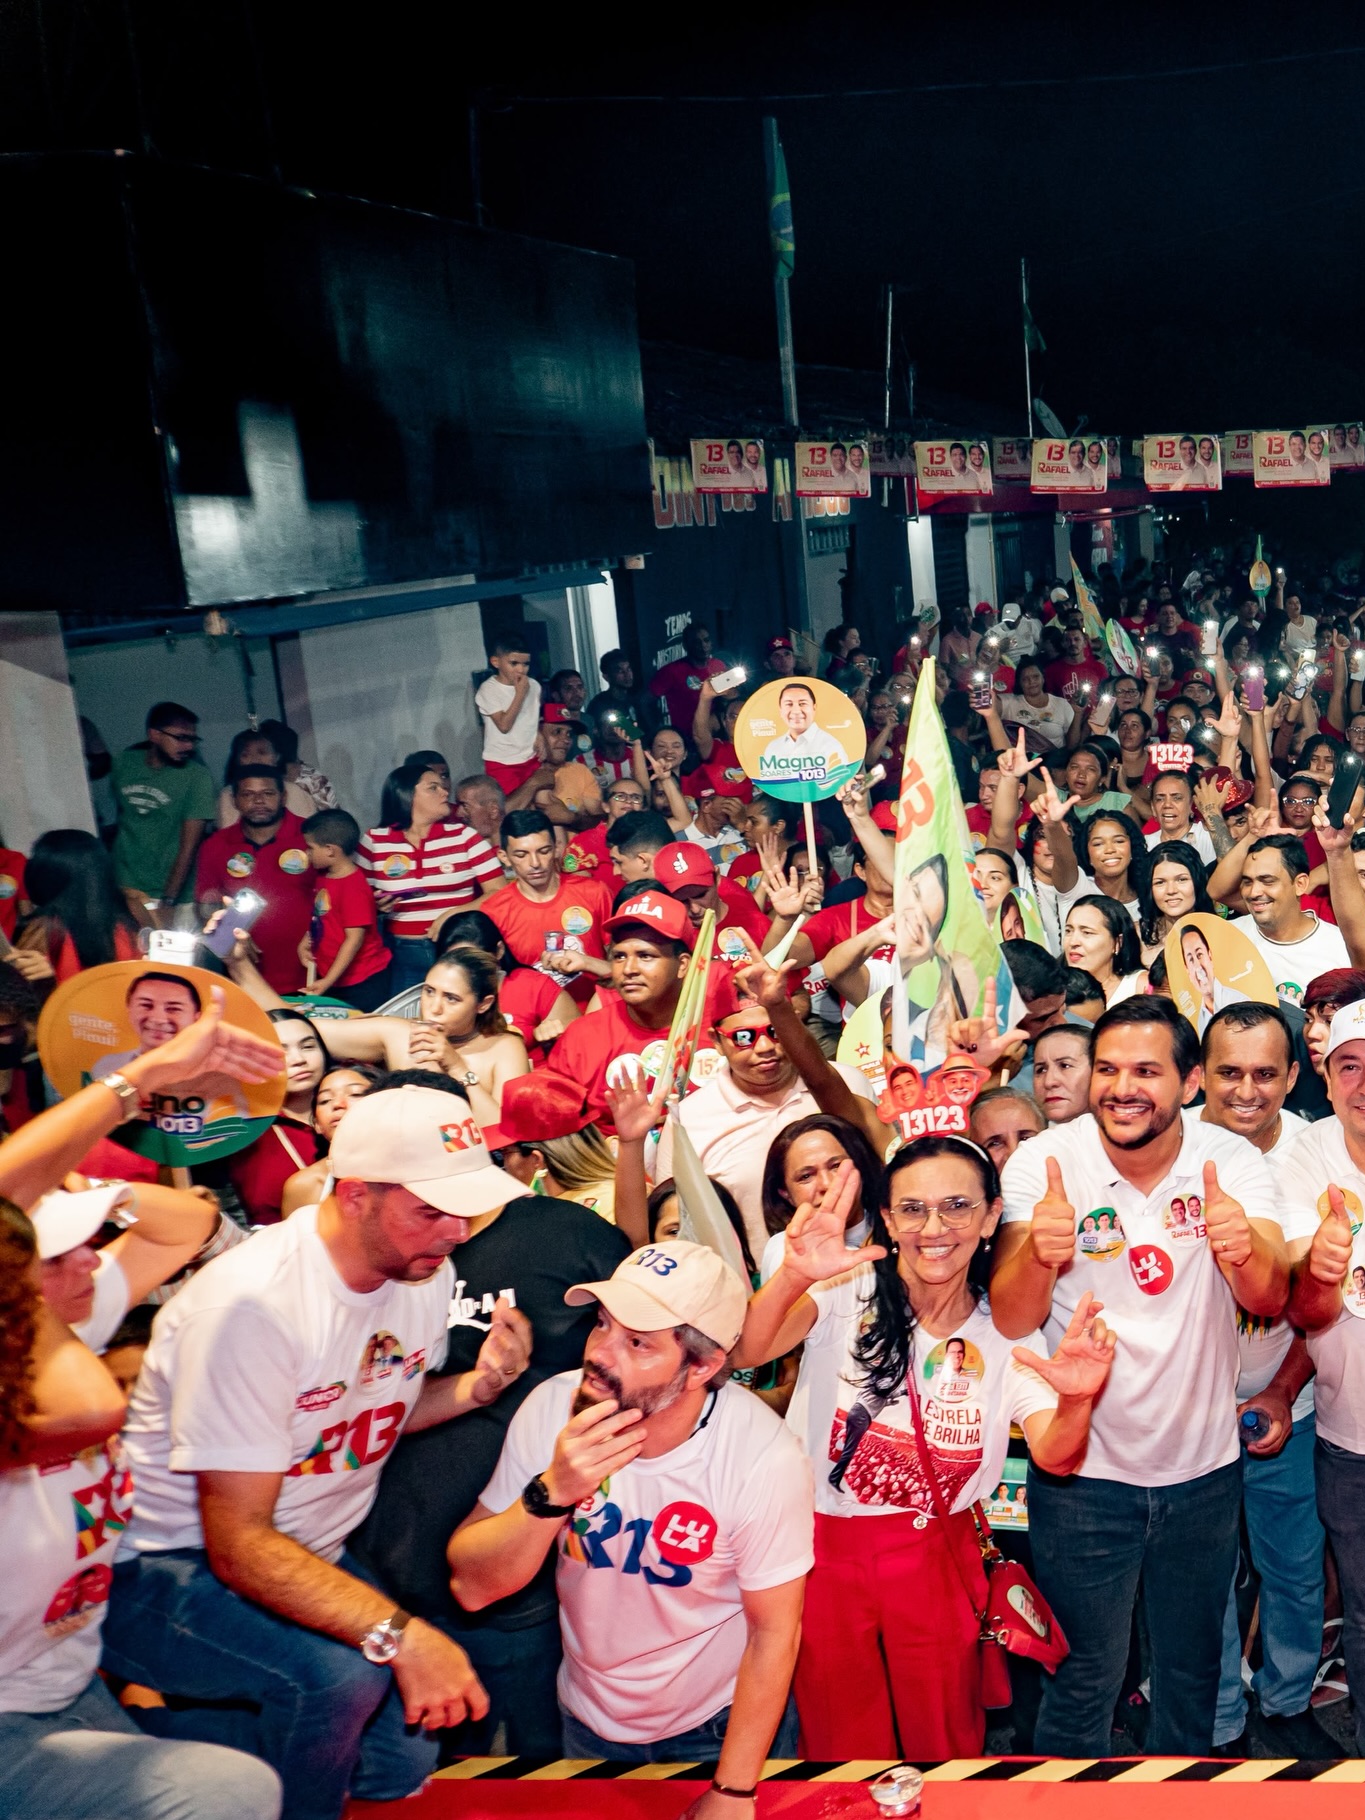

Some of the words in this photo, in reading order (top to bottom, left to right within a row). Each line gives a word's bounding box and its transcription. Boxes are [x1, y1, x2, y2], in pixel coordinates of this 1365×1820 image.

[1156, 441, 1176, 458] 13
[1235, 435, 1249, 449] 13
[1267, 436, 1285, 455] 13
[706, 444, 724, 462] 13
[809, 447, 827, 465] 13
[927, 447, 946, 465] 13
[1045, 444, 1065, 461] 13
[700, 464, 731, 475] RAFAEL
[1038, 462, 1071, 474] RAFAEL
[1151, 460, 1184, 471] RAFAEL
[1260, 456, 1293, 468] RAFAEL
[802, 467, 834, 478] RAFAEL
[923, 467, 955, 477] RAFAEL
[1150, 744, 1194, 765] 13123
[759, 755, 826, 772] Magno
[760, 770, 792, 778] SOARES
[800, 768, 825, 780] 1013
[897, 758, 935, 843] 13
[624, 904, 663, 920] LULA
[154, 1115, 201, 1134] 1013
[899, 1105, 967, 1139] 13123
[1193, 1224, 1207, 1239] 13
[284, 1401, 406, 1476] R13
[933, 1425, 980, 1445] BRILHA
